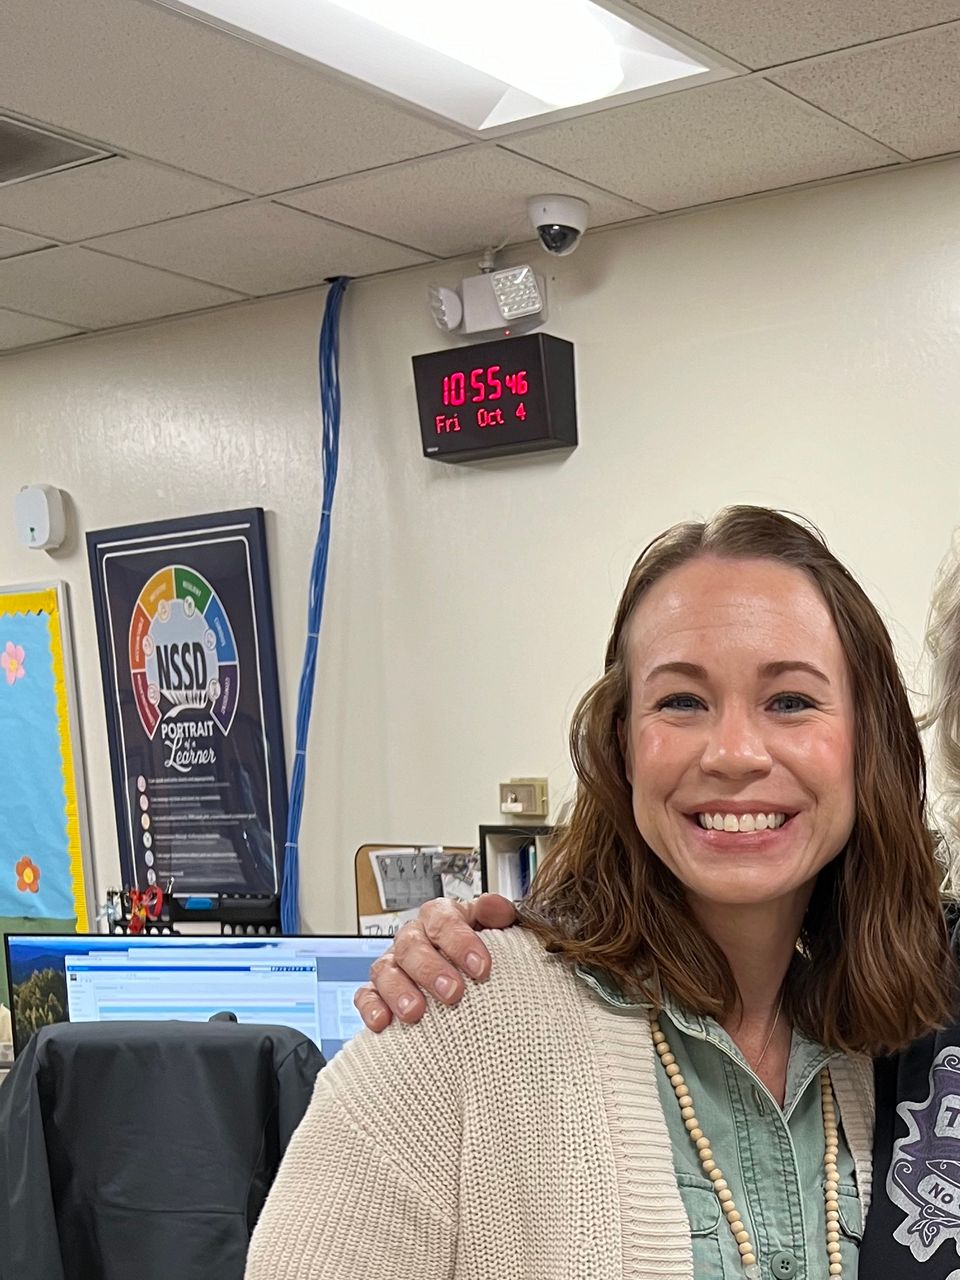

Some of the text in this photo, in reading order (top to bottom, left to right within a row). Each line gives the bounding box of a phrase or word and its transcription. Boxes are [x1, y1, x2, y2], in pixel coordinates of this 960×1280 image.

[505, 371, 528, 395] 46
[436, 402, 527, 433] Fri Oct 4
[156, 642, 208, 690] NSSD
[161, 720, 214, 739] PORTRAIT
[164, 736, 217, 773] Learner
[928, 1182, 955, 1204] NO
